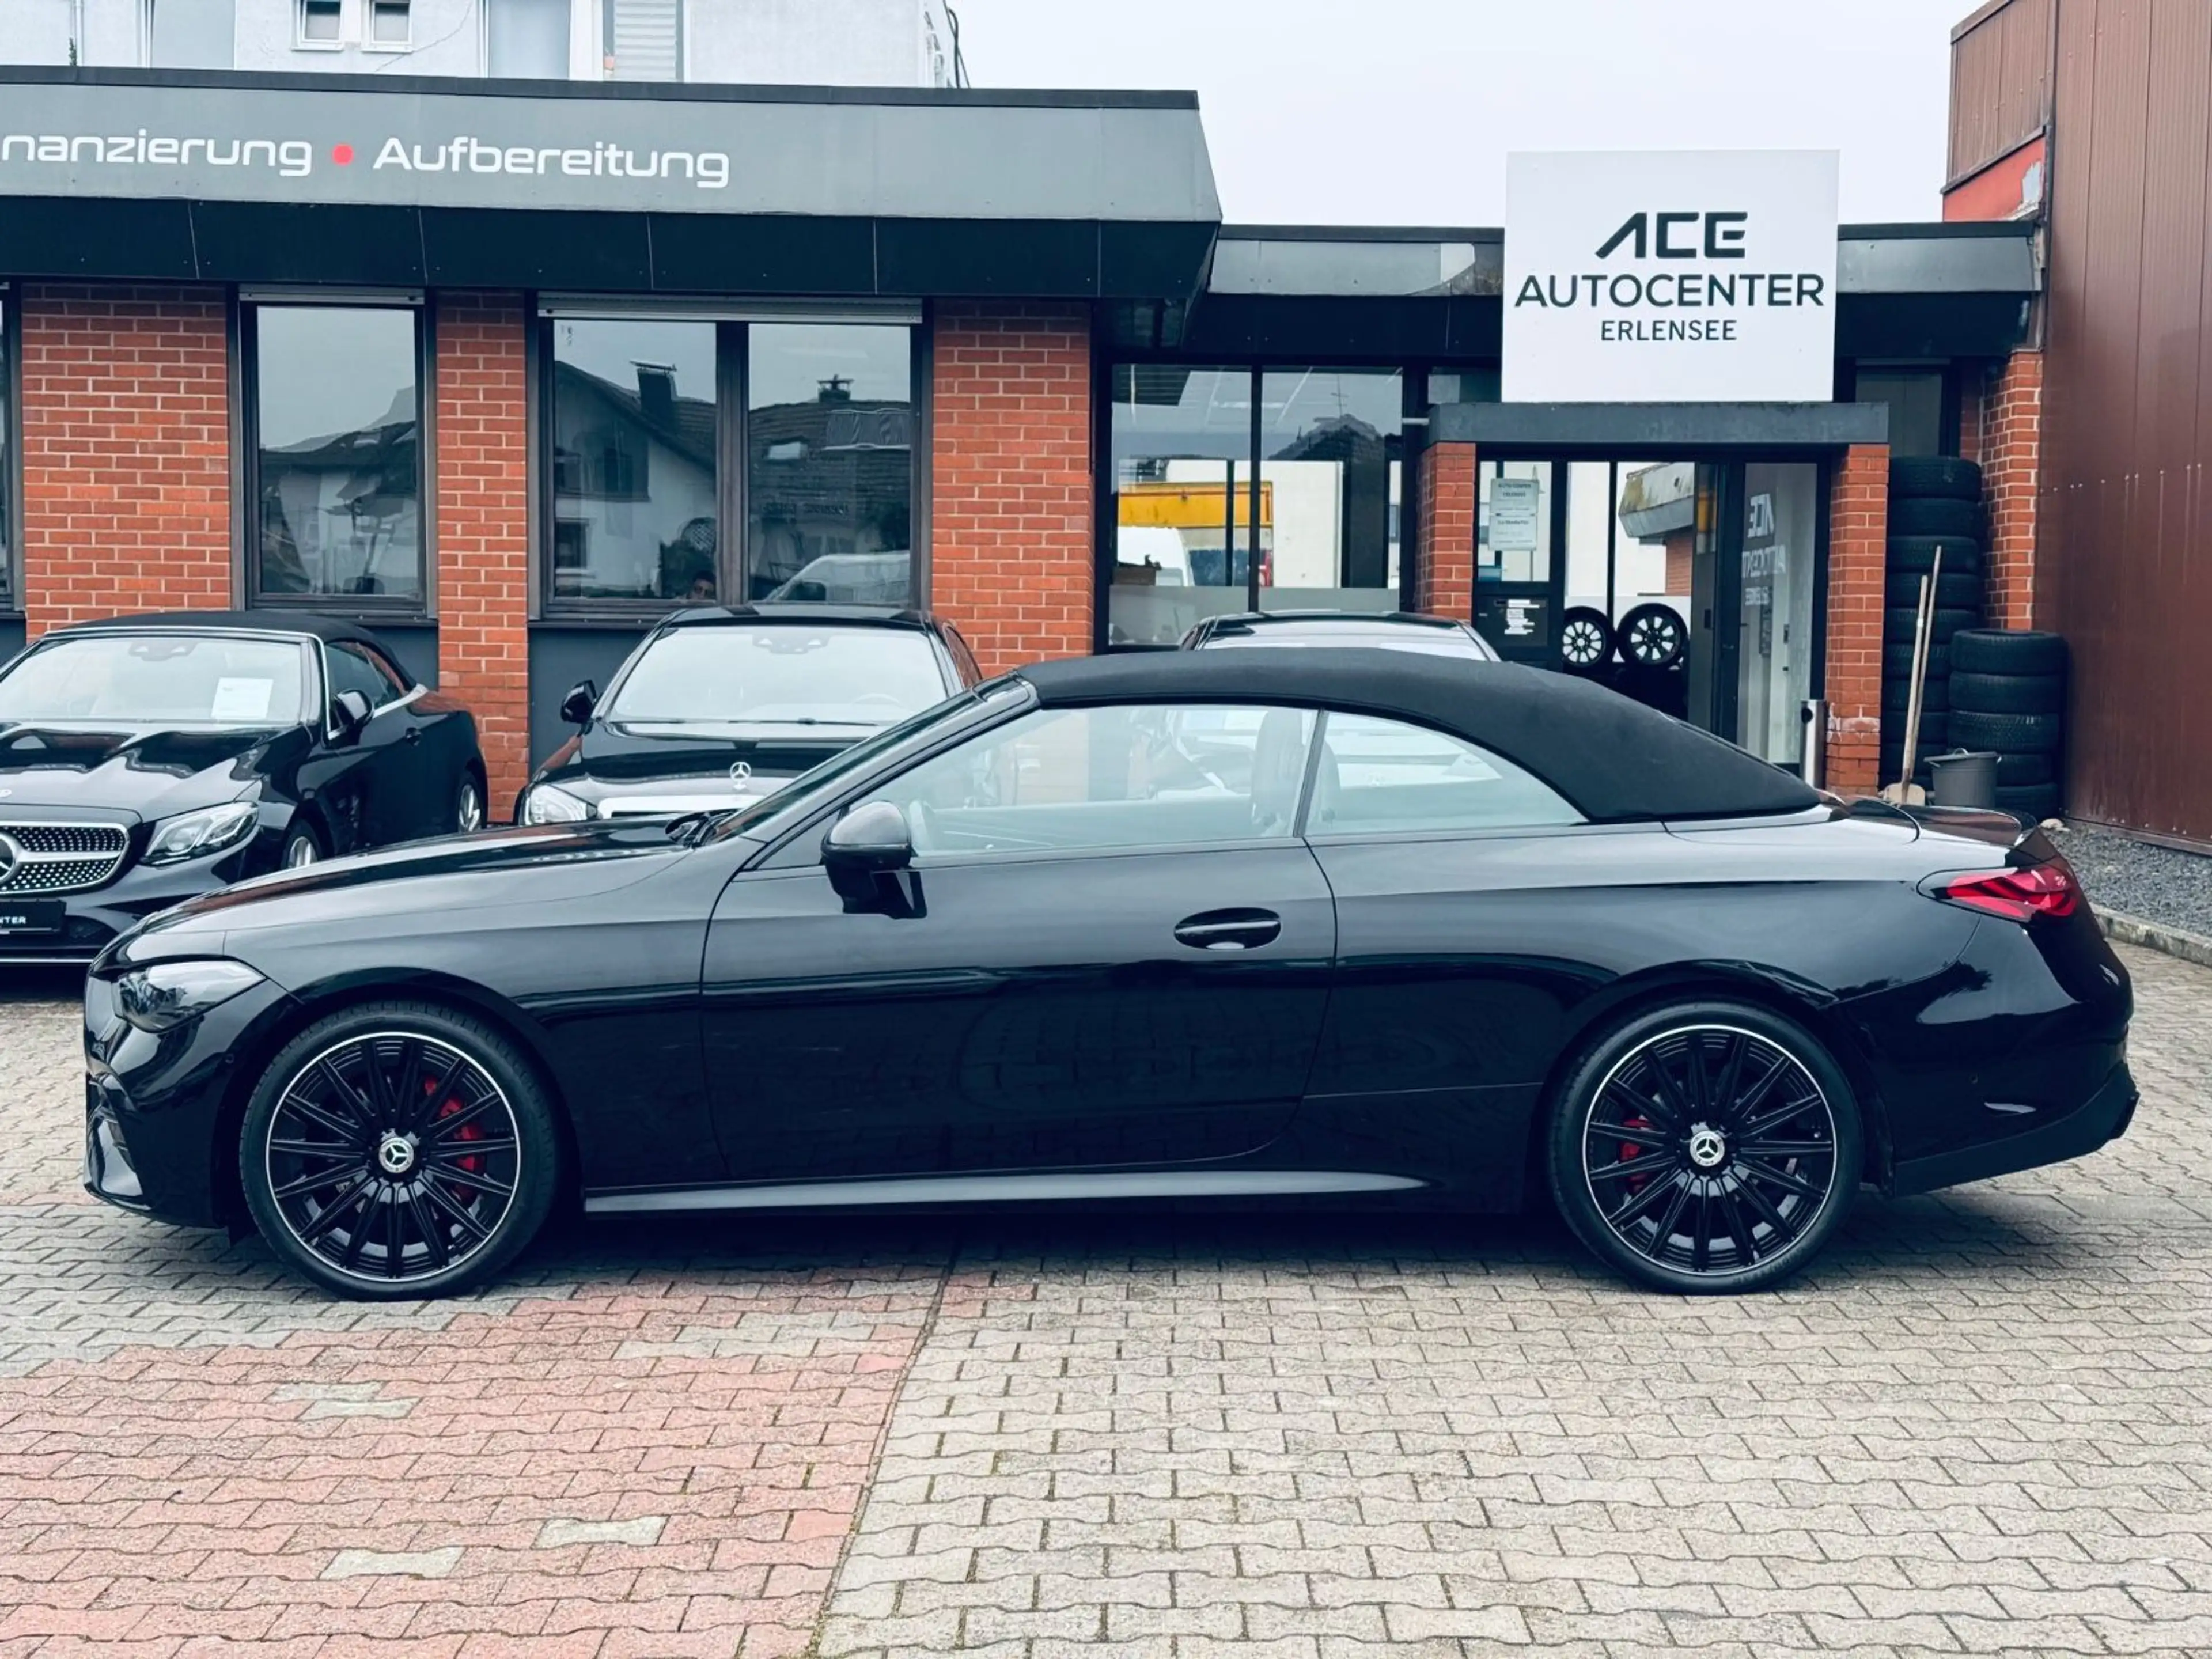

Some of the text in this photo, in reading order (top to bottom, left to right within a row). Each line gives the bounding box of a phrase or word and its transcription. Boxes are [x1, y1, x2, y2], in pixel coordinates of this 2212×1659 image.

[2, 128, 730, 189] nanzierung Aufbereitung
[1594, 211, 1748, 259] ACE
[1514, 274, 1824, 308] AUTOCENTER
[1600, 320, 1737, 341] ERLENSEE
